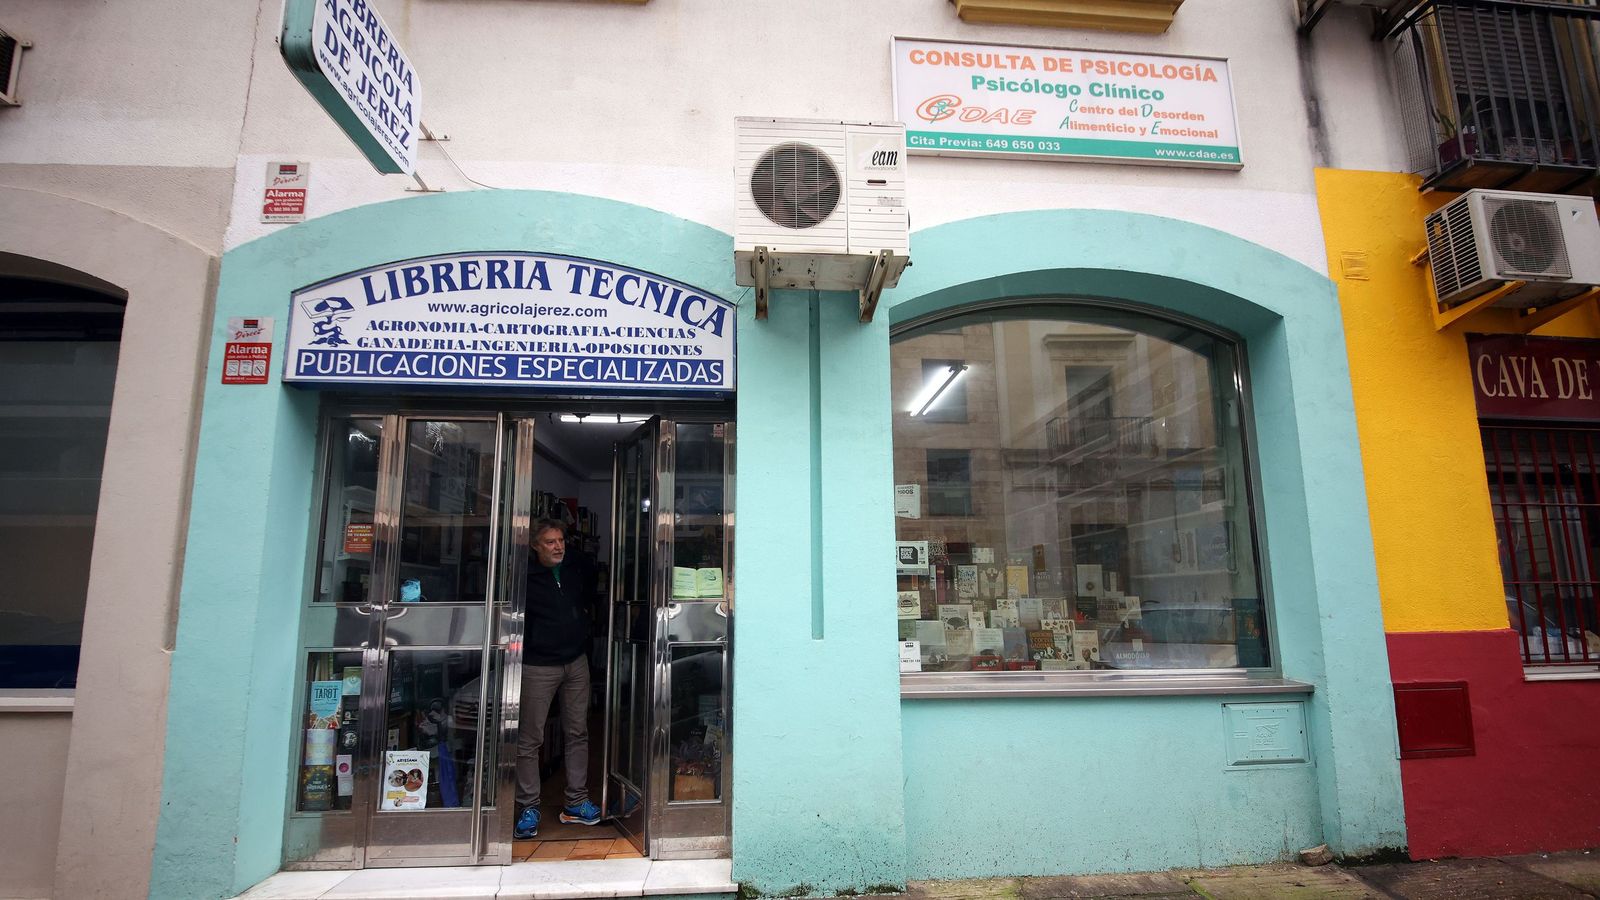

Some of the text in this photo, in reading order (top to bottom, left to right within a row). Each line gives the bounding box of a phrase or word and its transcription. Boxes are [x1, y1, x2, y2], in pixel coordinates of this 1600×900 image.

[346, 0, 413, 96] BRERIA
[325, 0, 413, 127] AGRICOLA
[909, 50, 1217, 82] CONSULTA DE PSICOLOGÍA
[324, 21, 409, 151] DE JEREZ
[971, 75, 1164, 100] Psicólogo Clínico
[320, 49, 409, 168] www.agricolajerez.com
[1069, 99, 1205, 121] Centro del Desorden
[1059, 116, 1218, 138] Alimenticio y Emocional
[910, 136, 1061, 151] Cita Previa: 649 650 033
[1154, 148, 1234, 160] www.cdae.es
[872, 151, 898, 166] eam
[266, 190, 304, 198] Alarma
[360, 259, 727, 338] LIBRERIA TECNICA
[428, 302, 608, 318] www.agricolajerez.com
[366, 320, 696, 339] AGRONOMIA-CARTOGRAFIA-CIENCIAS
[228, 345, 268, 354] Alarma
[357, 337, 703, 356] GANADERIA-INGENIERIA-OPOSICIONES
[299, 353, 722, 384] PUBLICACIONES ESPECIALIZADAS
[1477, 354, 1593, 400] CAVA DE
